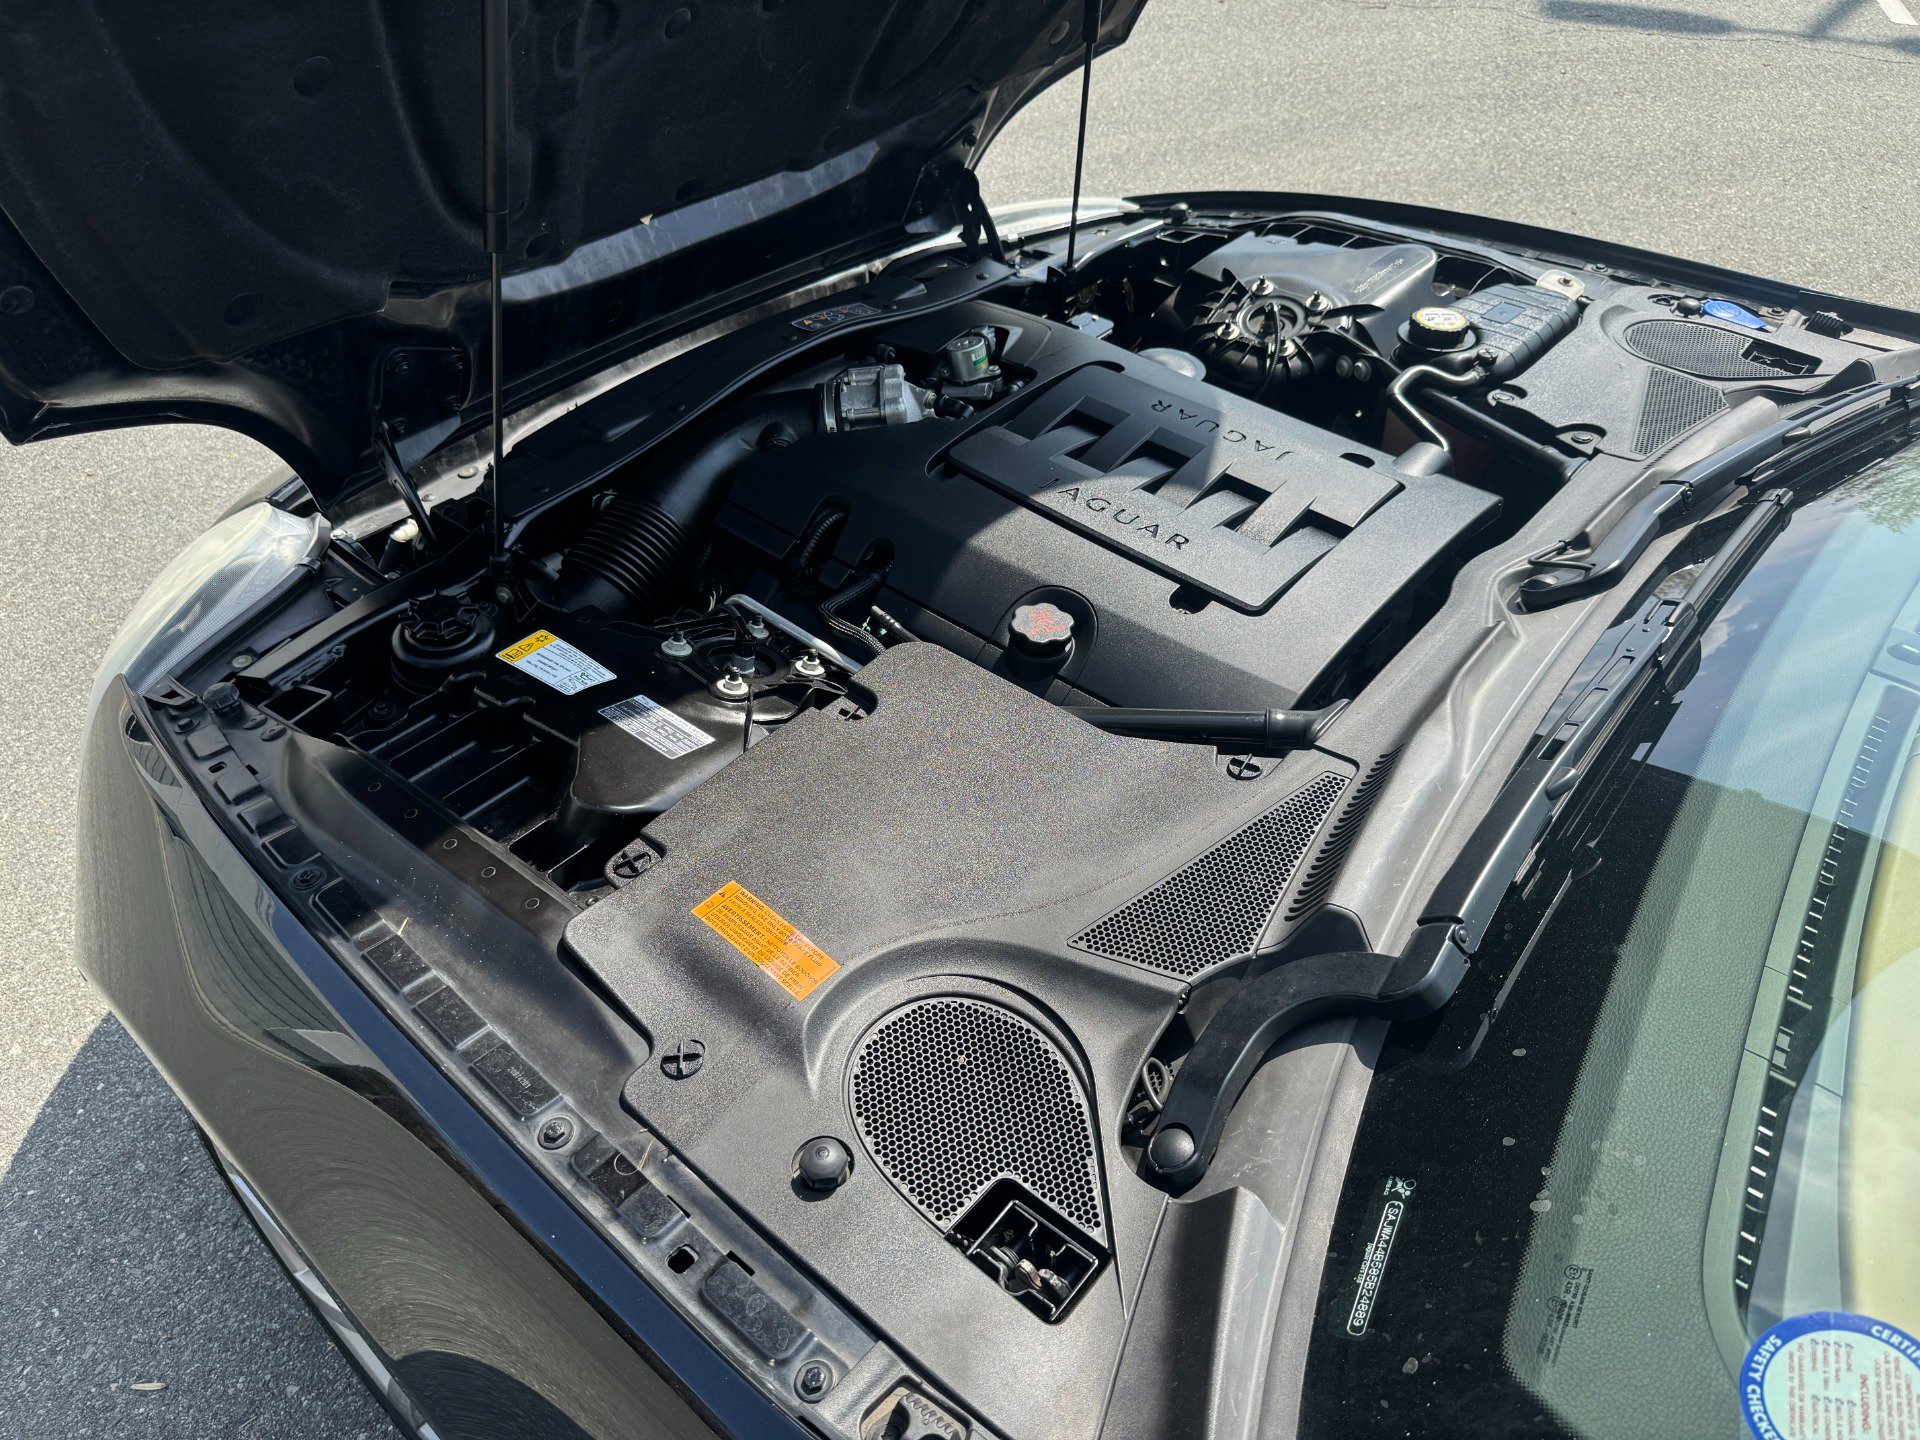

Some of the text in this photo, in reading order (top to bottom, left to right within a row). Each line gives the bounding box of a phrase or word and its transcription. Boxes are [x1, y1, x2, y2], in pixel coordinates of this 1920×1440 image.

[1150, 399, 1296, 461] JAGUAR
[1037, 477, 1190, 551] JAGUAR
[739, 890, 766, 911] WARNING:
[1352, 1207, 1399, 1327] SAJWA44B585B24889
[1746, 1334, 1782, 1440] SAFETY CHECKE
